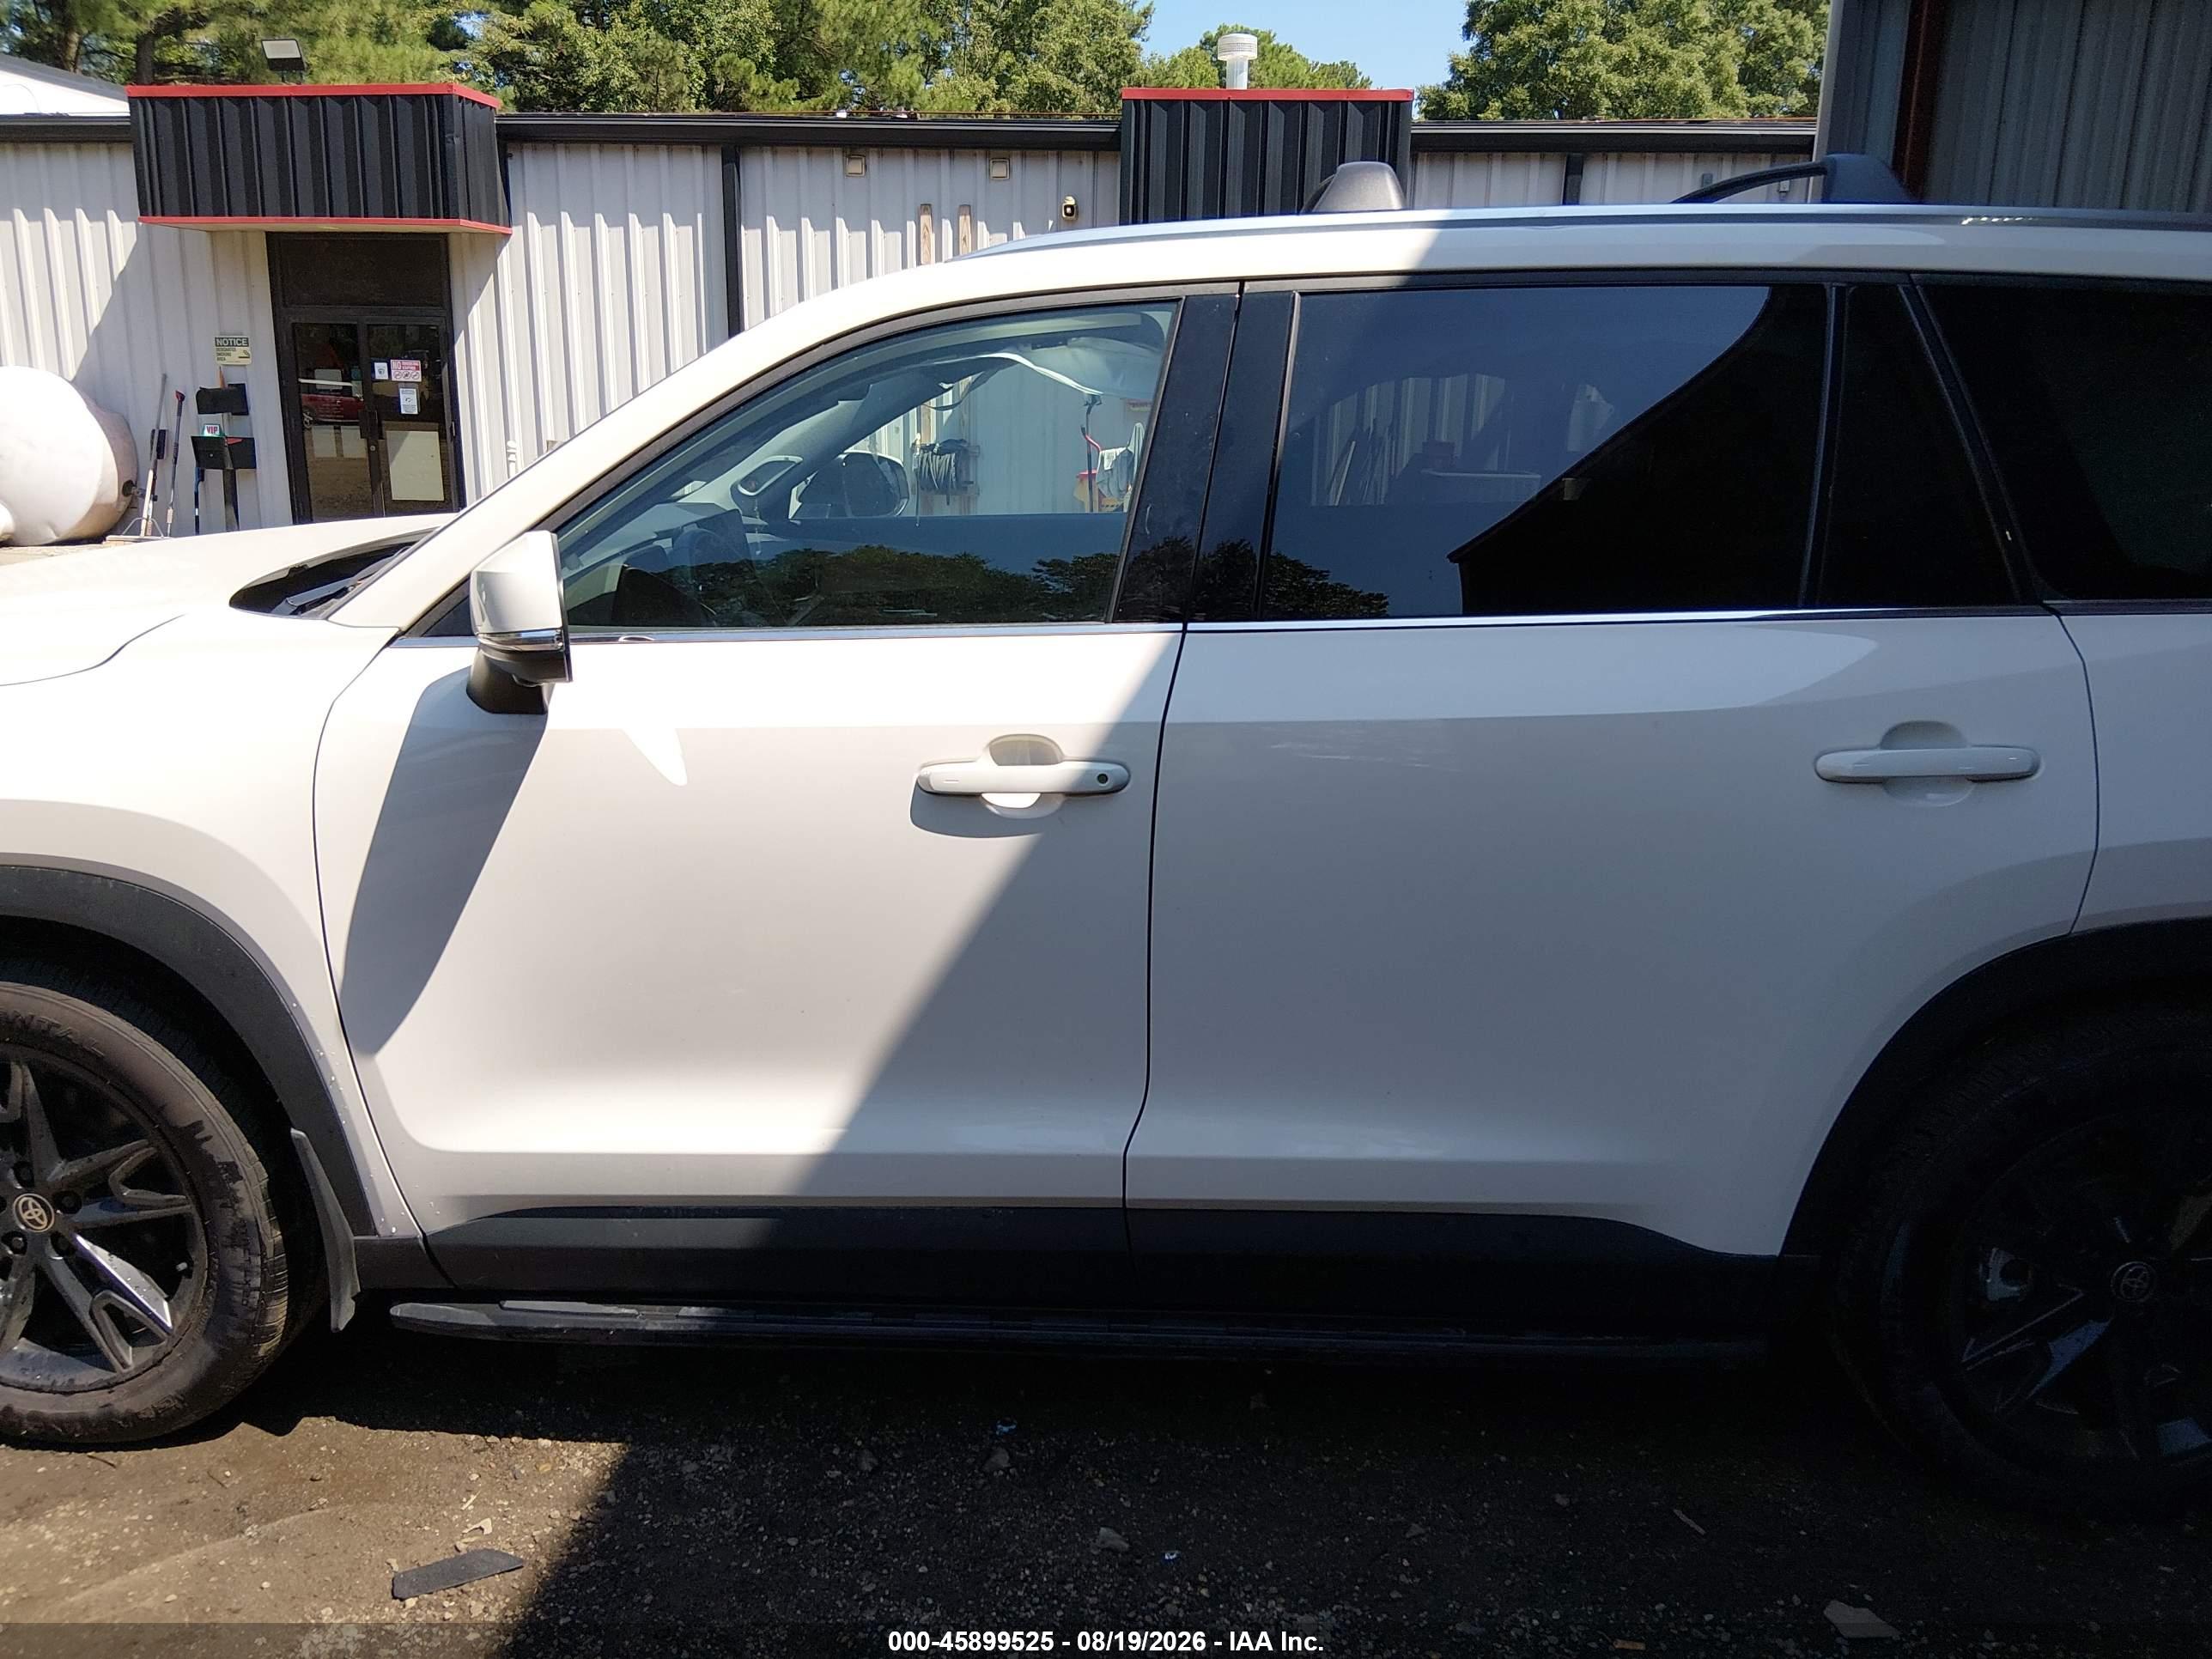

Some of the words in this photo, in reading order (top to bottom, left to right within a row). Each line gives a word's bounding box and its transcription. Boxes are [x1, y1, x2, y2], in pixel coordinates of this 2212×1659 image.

[216, 337, 248, 346] NOTICE
[392, 361, 402, 370] NO
[206, 425, 218, 434] VIP
